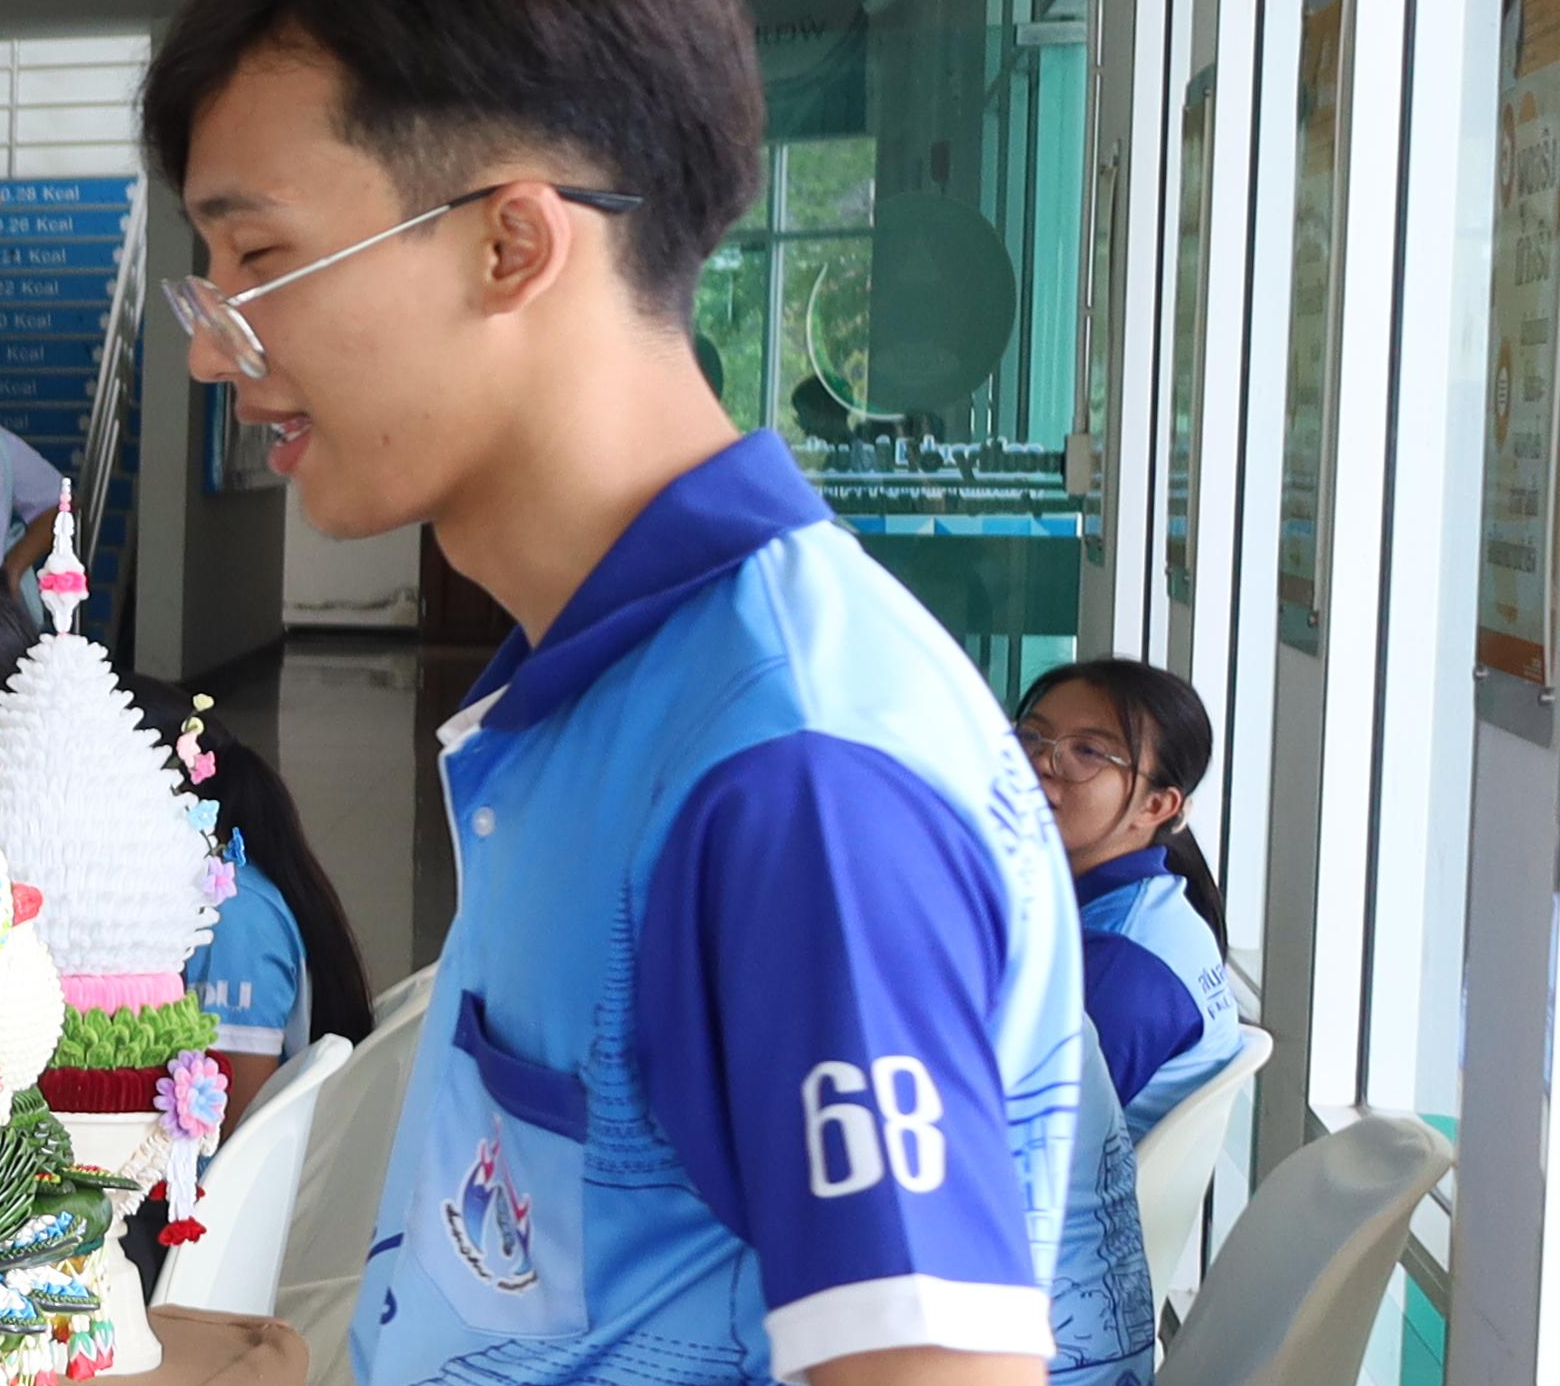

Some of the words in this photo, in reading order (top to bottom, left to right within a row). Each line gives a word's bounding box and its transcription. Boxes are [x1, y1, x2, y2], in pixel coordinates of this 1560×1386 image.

[43, 184, 80, 201] Kcal
[37, 215, 73, 232] Kcal
[29, 247, 66, 263] Kcal
[22, 280, 59, 295] Kcal
[14, 312, 52, 328] Kcal
[7, 345, 44, 361] Kcal
[804, 1055, 945, 1200] 68
